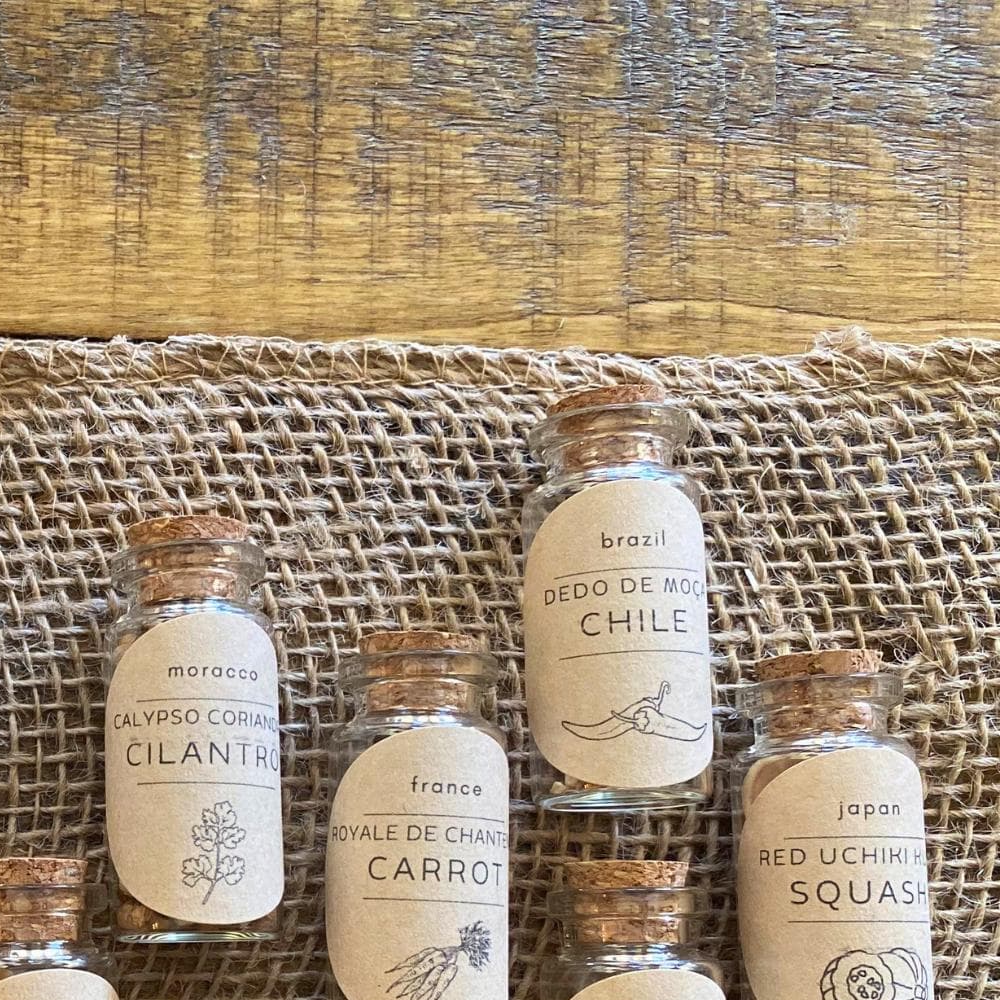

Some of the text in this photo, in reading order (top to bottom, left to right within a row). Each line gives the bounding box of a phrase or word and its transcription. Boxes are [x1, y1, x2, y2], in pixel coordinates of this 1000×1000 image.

[601, 530, 665, 549] brazil
[545, 579, 608, 605] DEDO
[621, 577, 653, 594] DE
[581, 609, 687, 636] CHILE
[168, 664, 258, 681] moracco
[114, 709, 199, 729] CALYPSO
[127, 741, 279, 771] CILANTRO
[411, 775, 482, 796] france
[838, 801, 900, 820] japan
[331, 824, 398, 842] ROYALE
[407, 825, 438, 842] DE
[759, 848, 805, 866] RED
[821, 847, 909, 866] UCHIKI
[368, 857, 502, 886] CARROT
[790, 880, 927, 910] SQUASH
